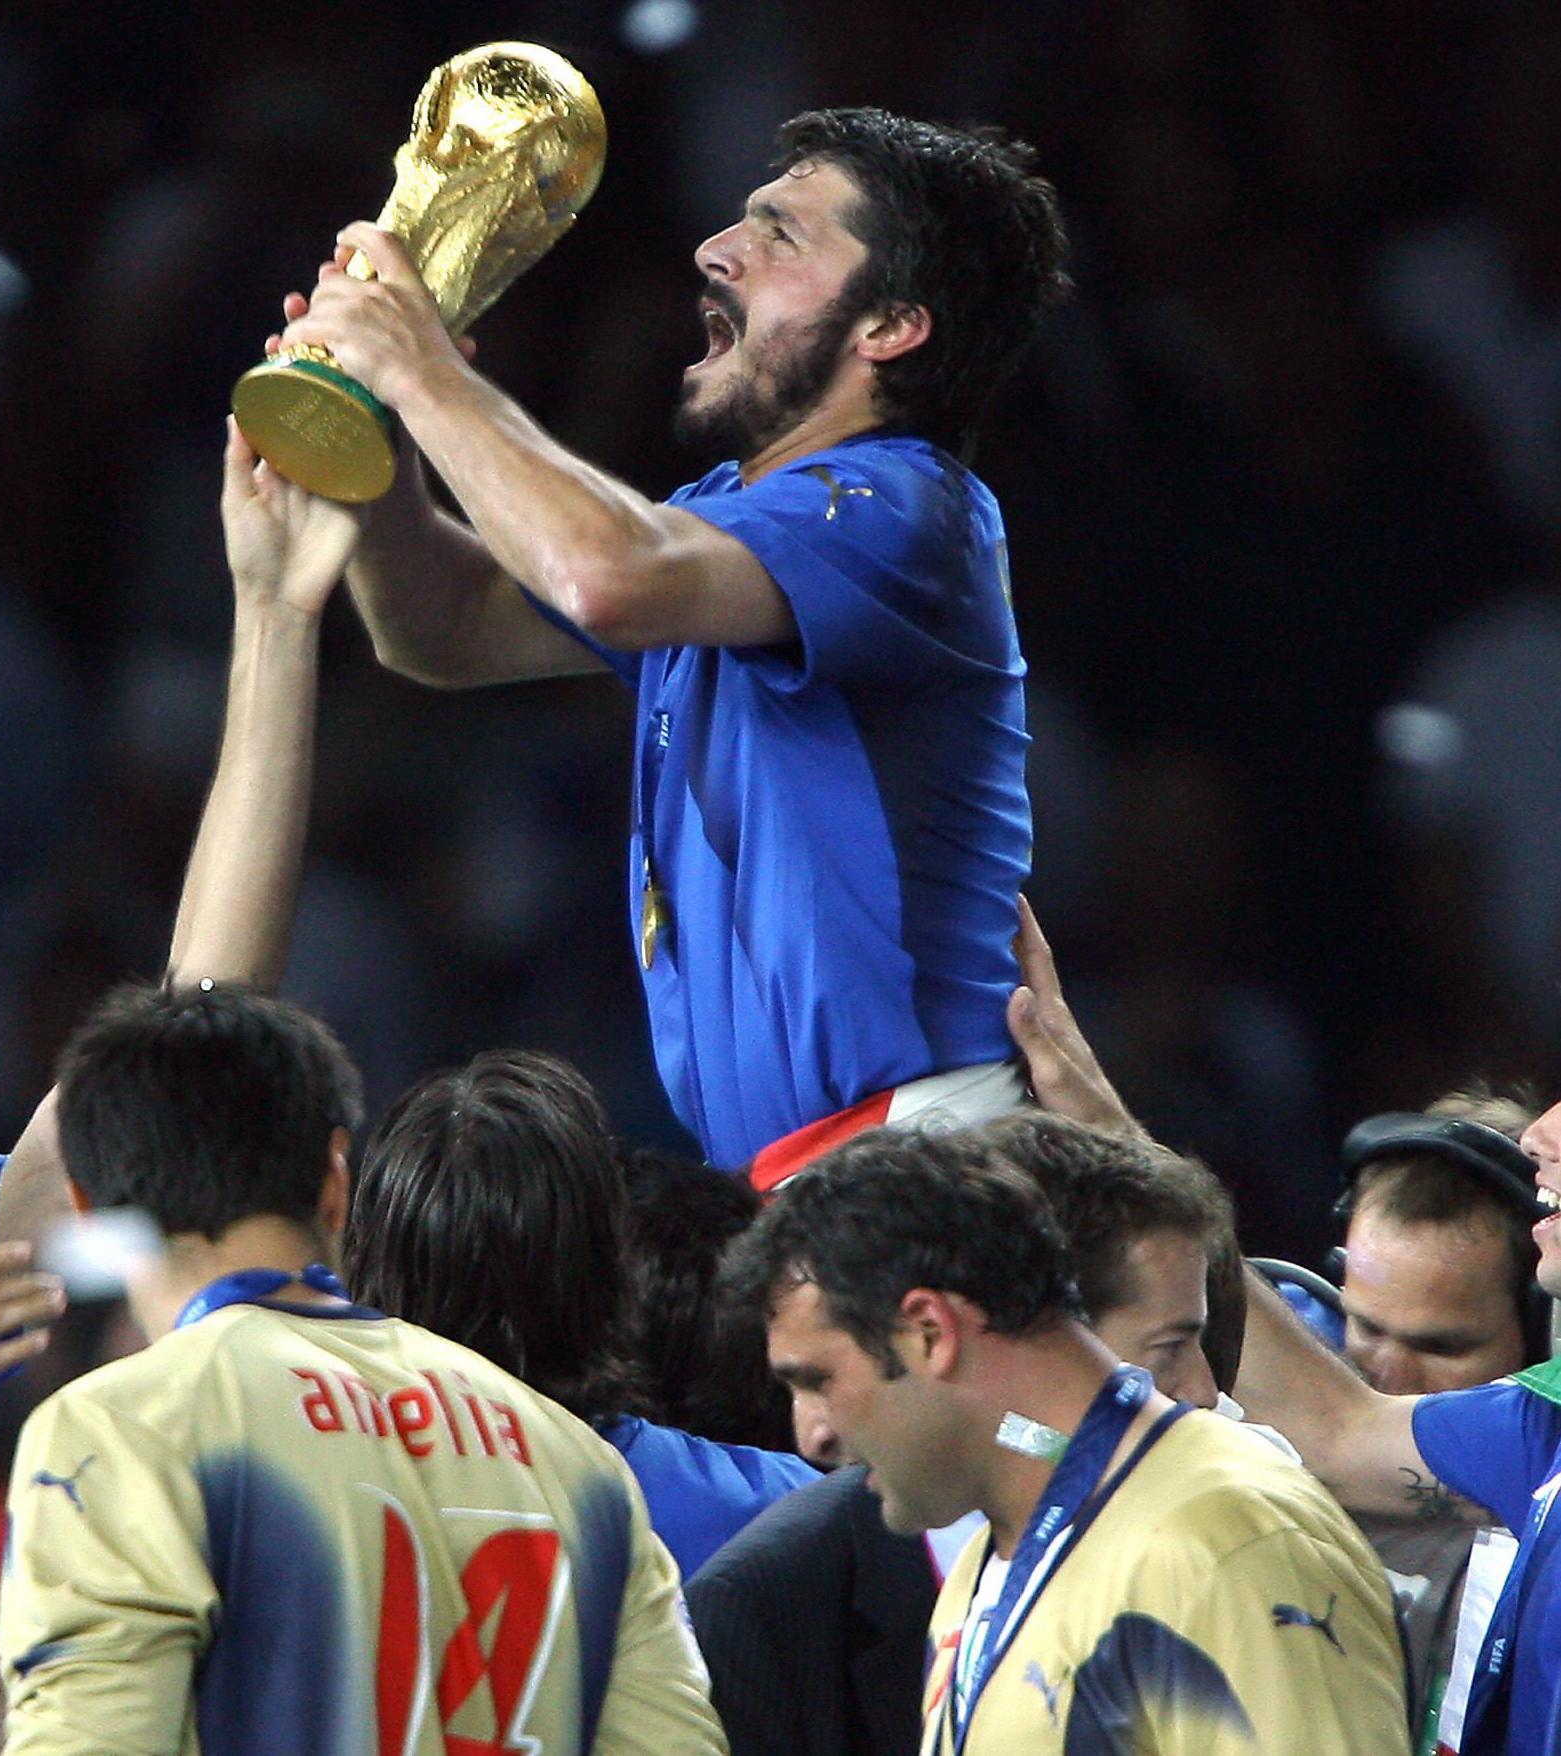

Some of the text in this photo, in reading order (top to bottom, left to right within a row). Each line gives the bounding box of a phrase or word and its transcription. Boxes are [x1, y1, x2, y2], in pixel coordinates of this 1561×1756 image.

[659, 713, 669, 748] FIFA
[358, 1484, 570, 1756] 14
[1490, 1637, 1507, 1674] FIFA
